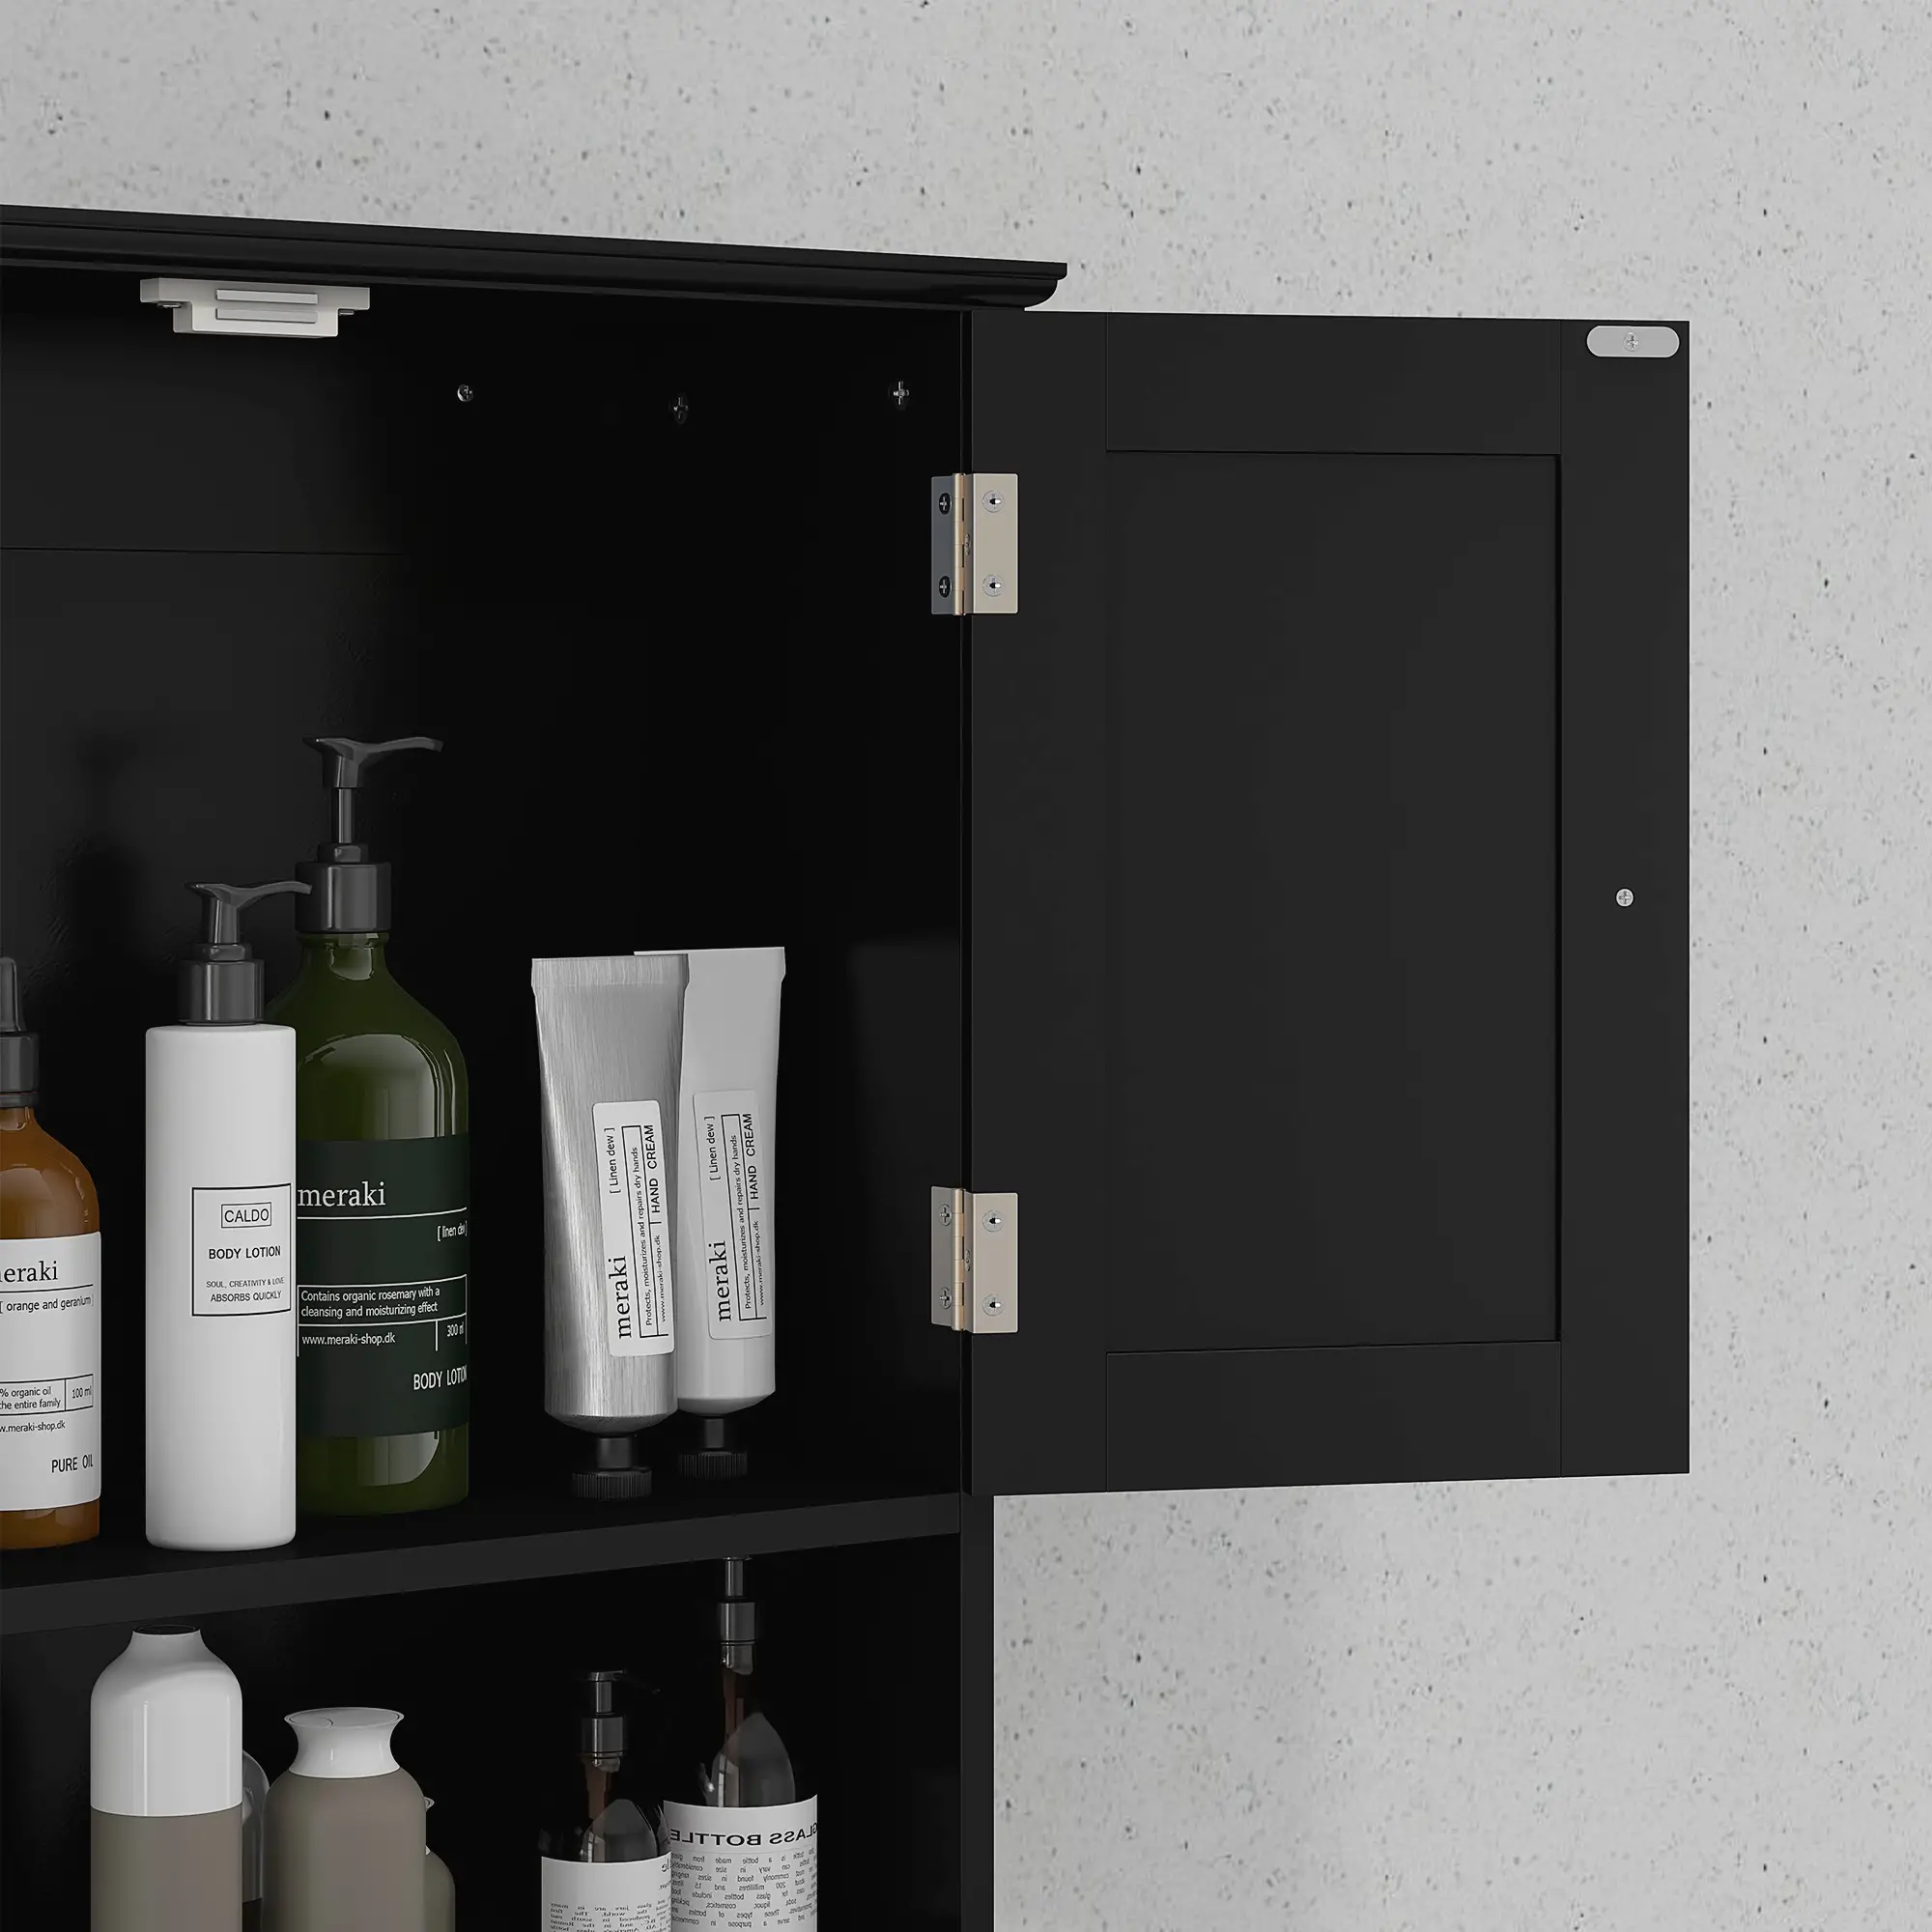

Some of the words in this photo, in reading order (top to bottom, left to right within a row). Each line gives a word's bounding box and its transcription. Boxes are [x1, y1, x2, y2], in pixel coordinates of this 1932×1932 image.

[706, 1123, 716, 1145] dew
[742, 1113, 756, 1156] CREAM
[606, 1135, 616, 1156] dew
[643, 1124, 658, 1170] CREAM
[729, 1134, 739, 1159] hands
[630, 1147, 639, 1173] hands
[708, 1147, 719, 1174] Linen
[732, 1162, 741, 1176] dry
[609, 1158, 619, 1186] Linen
[633, 1175, 642, 1188] dry
[747, 1165, 759, 1200] HAND
[297, 1180, 386, 1208] meraki
[648, 1178, 661, 1213] HAND
[734, 1177, 744, 1206] repairs
[635, 1190, 645, 1219] repairs
[224, 1208, 270, 1223] CALDO
[736, 1208, 745, 1224] and
[637, 1222, 646, 1237] and
[209, 1248, 242, 1259] BODY
[245, 1245, 281, 1259] LOTION
[738, 1225, 749, 1271] moisturizes
[639, 1239, 650, 1287] moisturizes
[753, 1220, 765, 1306] www.meraki-shop.dk
[206, 1280, 227, 1289] SOUL,
[229, 1278, 267, 1288] CREATIVITY
[271, 1276, 285, 1286] LOVE
[654, 1235, 667, 1322] www.meraki-shop.dk
[708, 1240, 732, 1321] meraki
[210, 1293, 251, 1302] ABSORBS
[252, 1291, 282, 1301] QUICKLY
[301, 1290, 340, 1301] Contains
[342, 1290, 377, 1304] organic
[378, 1289, 417, 1301] rosemary
[417, 1286, 434, 1297] with
[435, 1287, 440, 1296] a
[608, 1256, 632, 1340] meraki
[743, 1273, 752, 1309] Protects,
[6, 1301, 40, 1314] orange
[42, 1298, 58, 1310] and
[60, 1295, 91, 1311] geranium
[301, 1306, 343, 1320] cleansing
[345, 1305, 363, 1317] and
[365, 1303, 416, 1316] moisturizing
[417, 1300, 439, 1314] effect
[301, 1332, 396, 1347] www.meraki-shop.dk
[446, 1323, 459, 1337] 300
[413, 1371, 442, 1390] BODY
[11, 1387, 41, 1399] organic
[42, 1385, 52, 1396] oil
[71, 1387, 83, 1399] 100
[14, 1399, 38, 1408] entire
[39, 1398, 61, 1407] family
[51, 1457, 78, 1473] PURE
[82, 1454, 94, 1468] OIL
